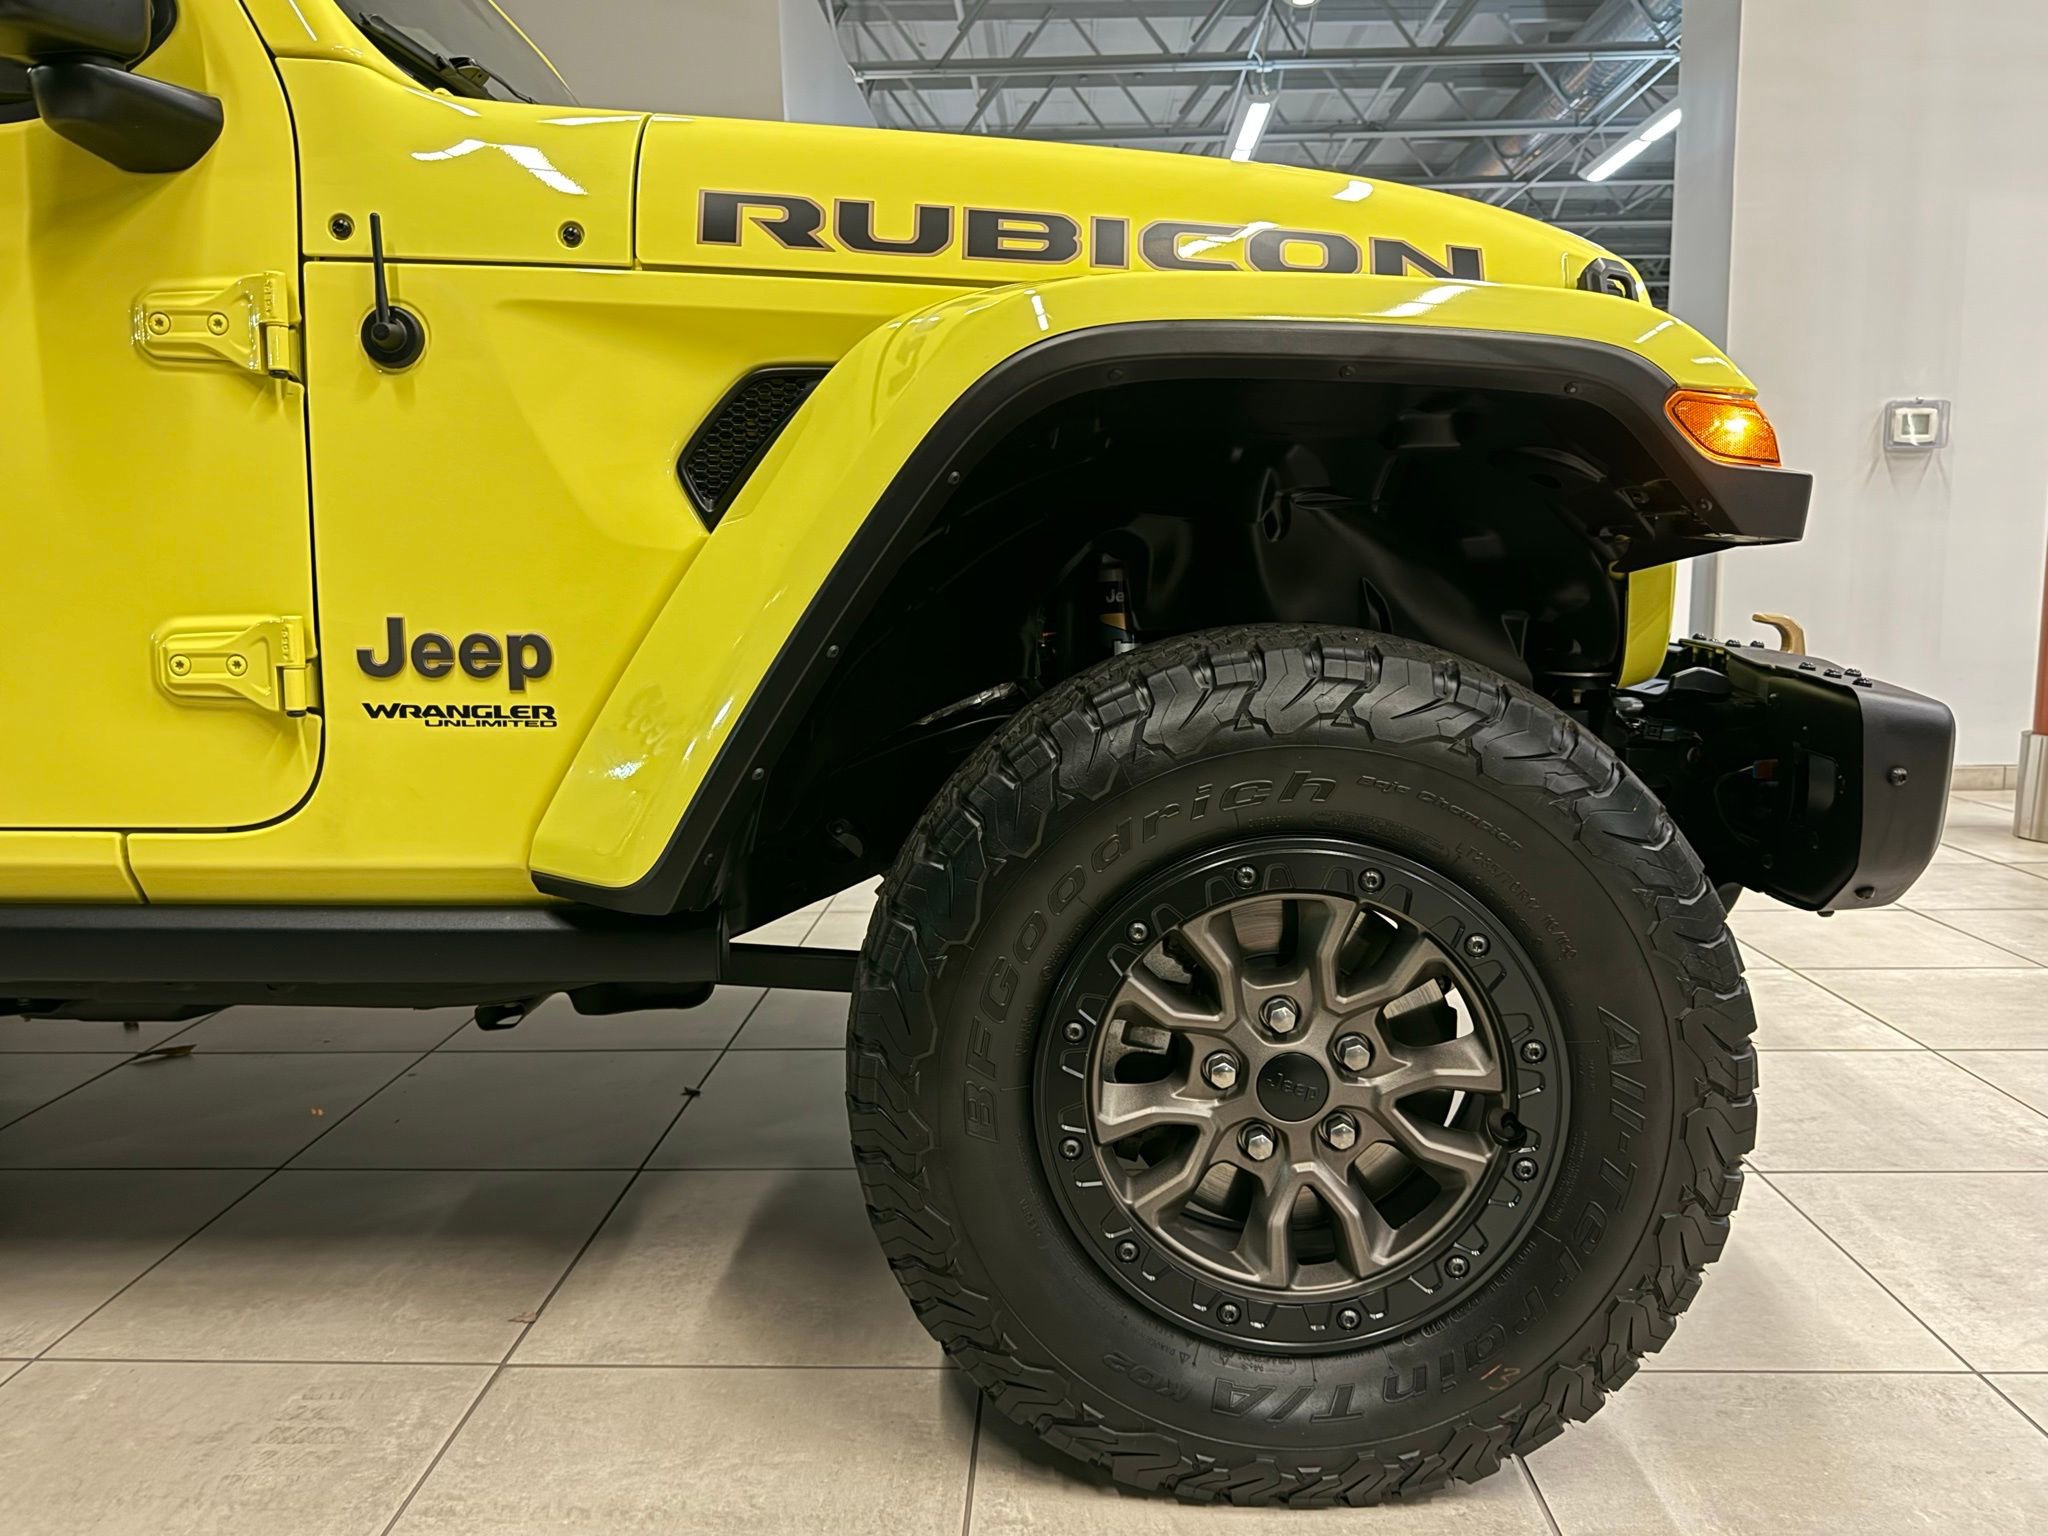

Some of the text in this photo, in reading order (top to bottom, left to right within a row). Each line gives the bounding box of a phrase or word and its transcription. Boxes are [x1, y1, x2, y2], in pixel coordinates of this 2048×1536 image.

[696, 189, 1484, 281] RUBICON
[356, 616, 553, 693] Jeep
[362, 702, 557, 719] WRANGLER
[424, 719, 558, 729] UNLIMITED
[963, 769, 1337, 1143] BFGoodrich
[1265, 1072, 1319, 1102] Jeep
[1210, 1377, 1367, 1424] T/A
